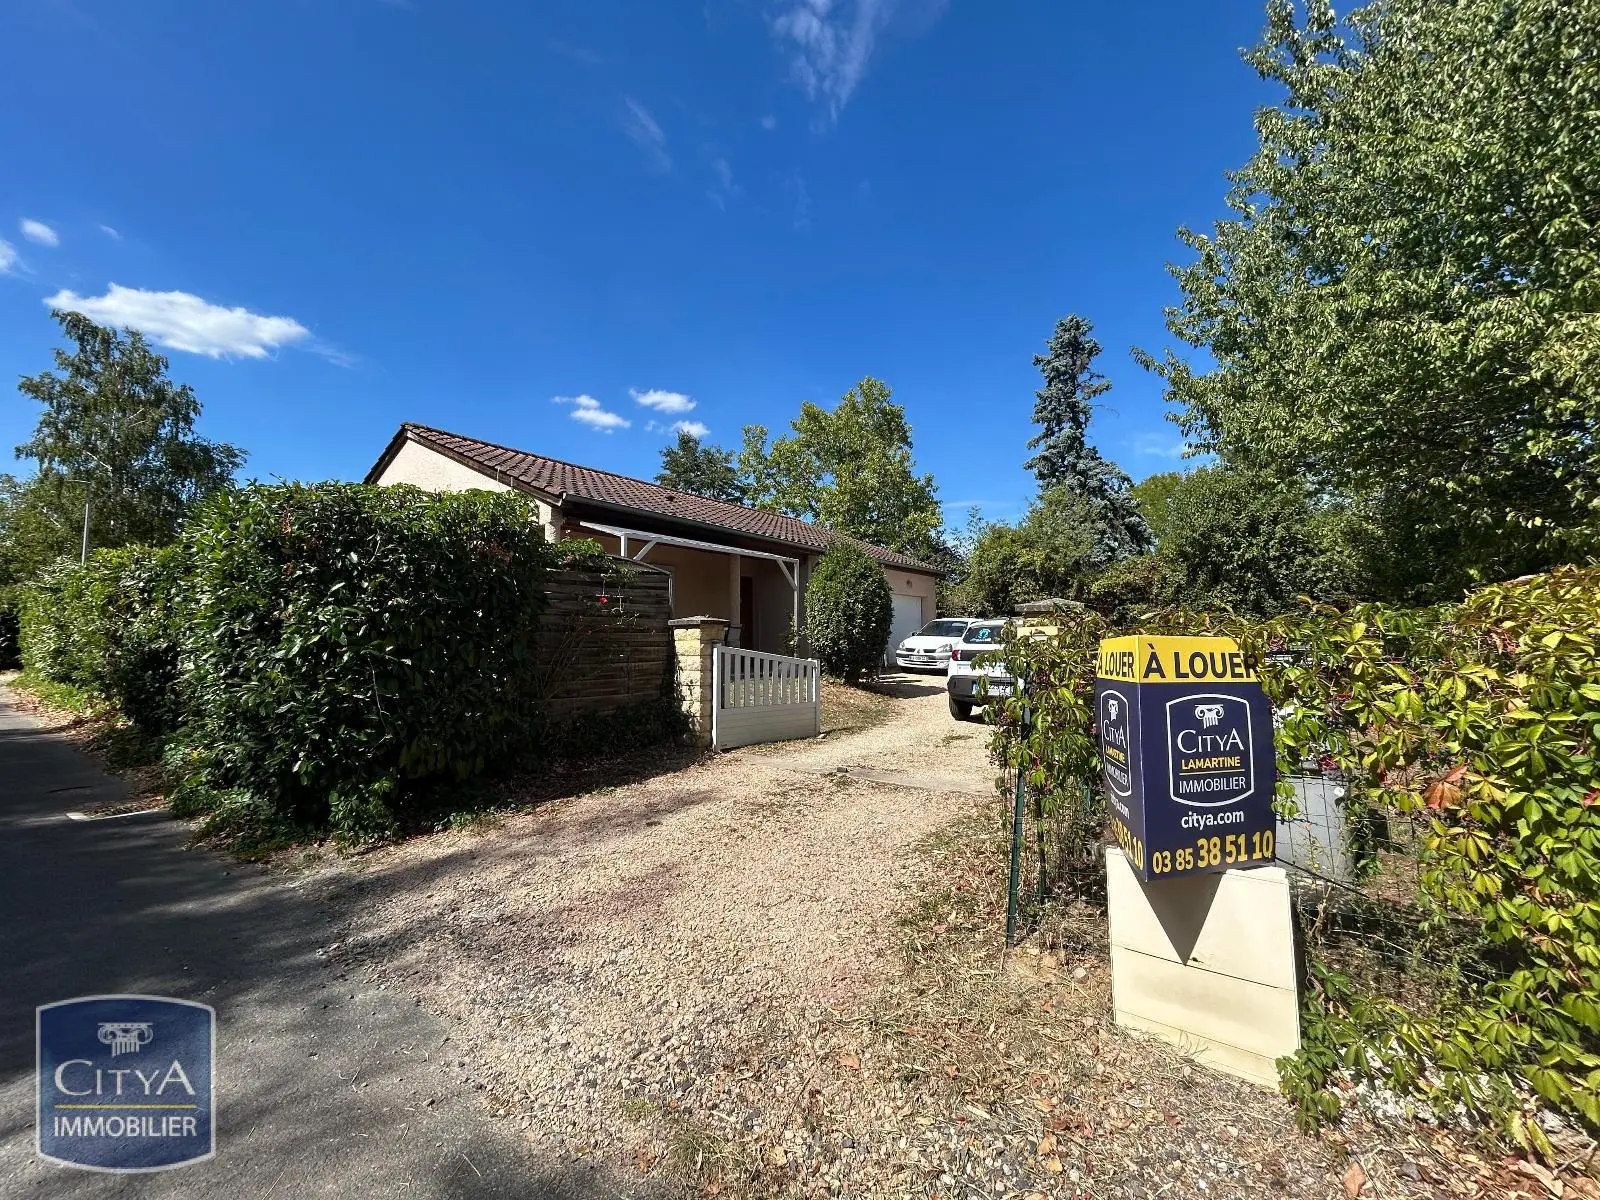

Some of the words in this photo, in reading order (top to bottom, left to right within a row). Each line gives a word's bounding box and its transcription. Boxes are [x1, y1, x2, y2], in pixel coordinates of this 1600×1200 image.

[1105, 651, 1135, 678] LOUER
[1143, 643, 1165, 679] À
[1173, 651, 1259, 679] LOUER
[1181, 756, 1241, 770] LAMARTINE
[1179, 776, 1246, 794] IMMOBILIER
[1181, 809, 1245, 831] citya.com
[1132, 836, 1144, 871] 10
[1152, 851, 1172, 874] 03
[1175, 848, 1194, 871] 85
[1197, 836, 1221, 869] 38
[1225, 833, 1247, 865] 51
[1252, 830, 1274, 860] 10
